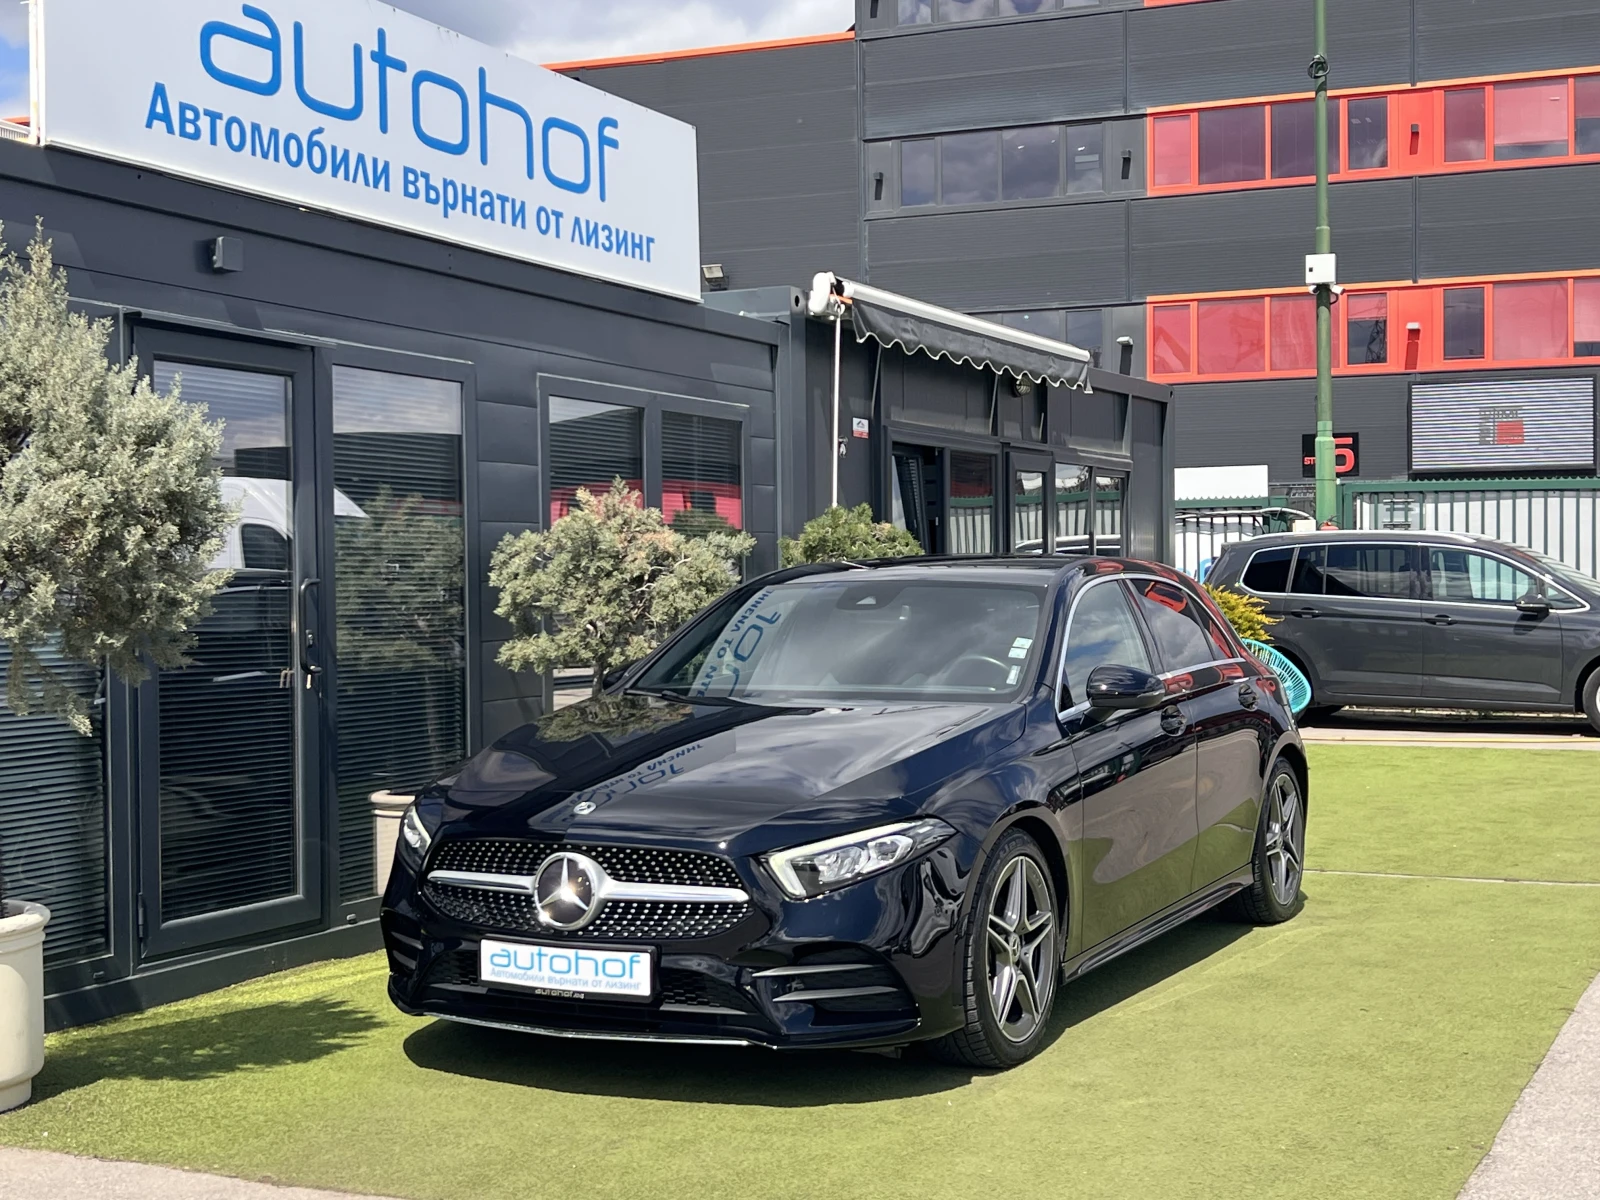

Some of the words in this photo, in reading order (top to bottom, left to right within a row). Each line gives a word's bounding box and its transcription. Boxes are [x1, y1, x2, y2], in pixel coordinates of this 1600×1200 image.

[199, 3, 620, 203] autohof
[144, 82, 391, 193] Автомобили
[402, 165, 527, 230] върнати
[535, 205, 564, 239] от
[570, 216, 656, 262] лизинг
[489, 946, 641, 979] autohof
[489, 968, 545, 983] Автомобили
[548, 975, 589, 988] върнати
